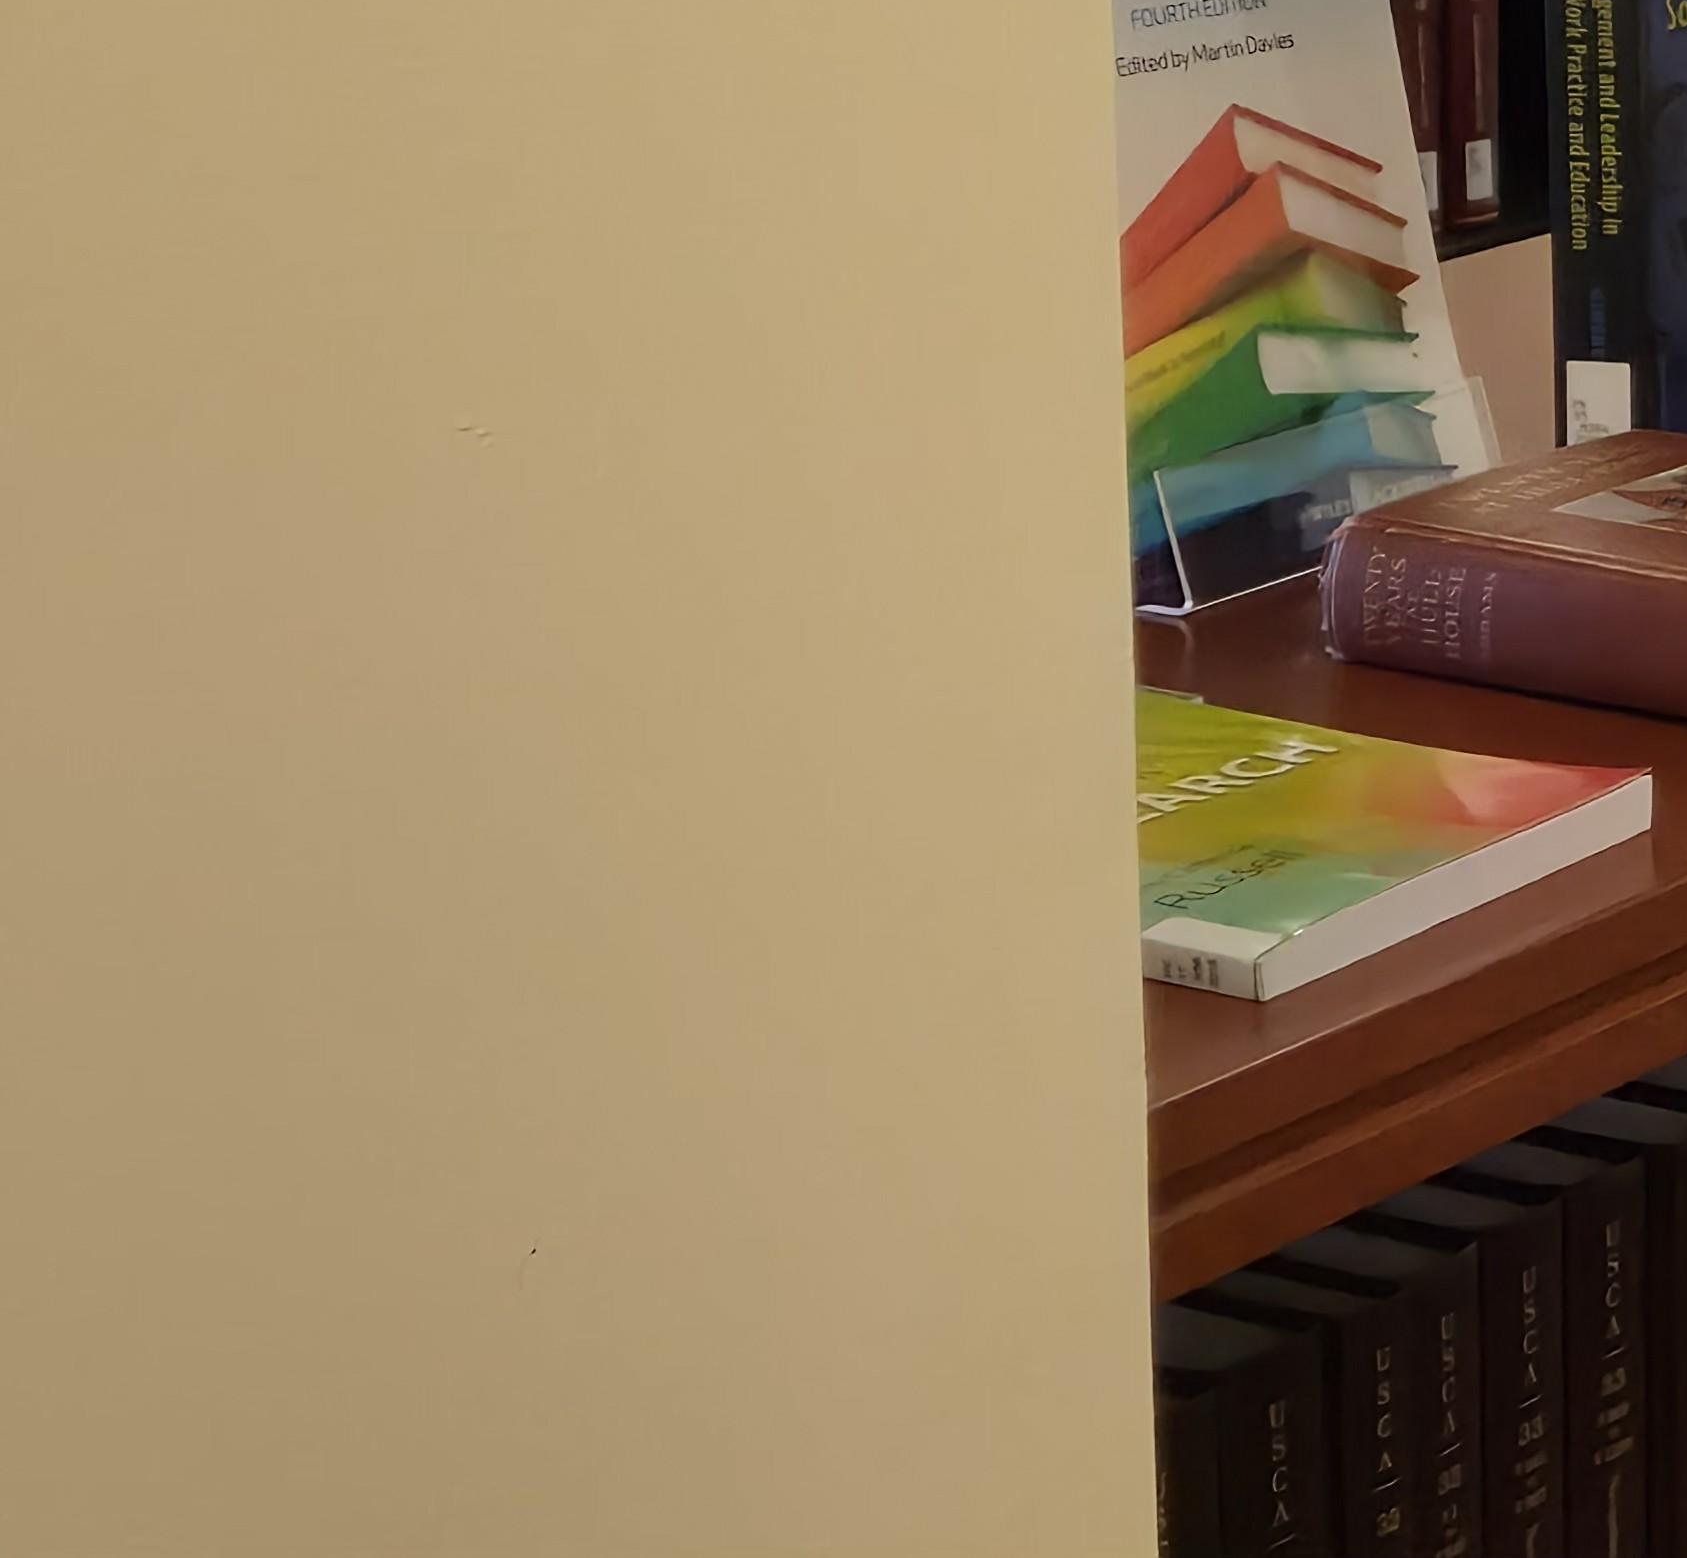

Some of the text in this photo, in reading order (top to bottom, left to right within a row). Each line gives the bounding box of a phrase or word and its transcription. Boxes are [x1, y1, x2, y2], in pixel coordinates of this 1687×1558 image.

[1131, 3, 1200, 30] FOURTH
[1115, 33, 1295, 77] Edited by Martin Davies
[1567, 43, 1588, 117] Practice
[1598, 73, 1621, 108] and
[1569, 121, 1590, 156] and
[1597, 113, 1623, 213] Leadership
[1570, 161, 1591, 251] Education
[1603, 218, 1623, 236] in
[1444, 567, 1468, 659] HOUSE
